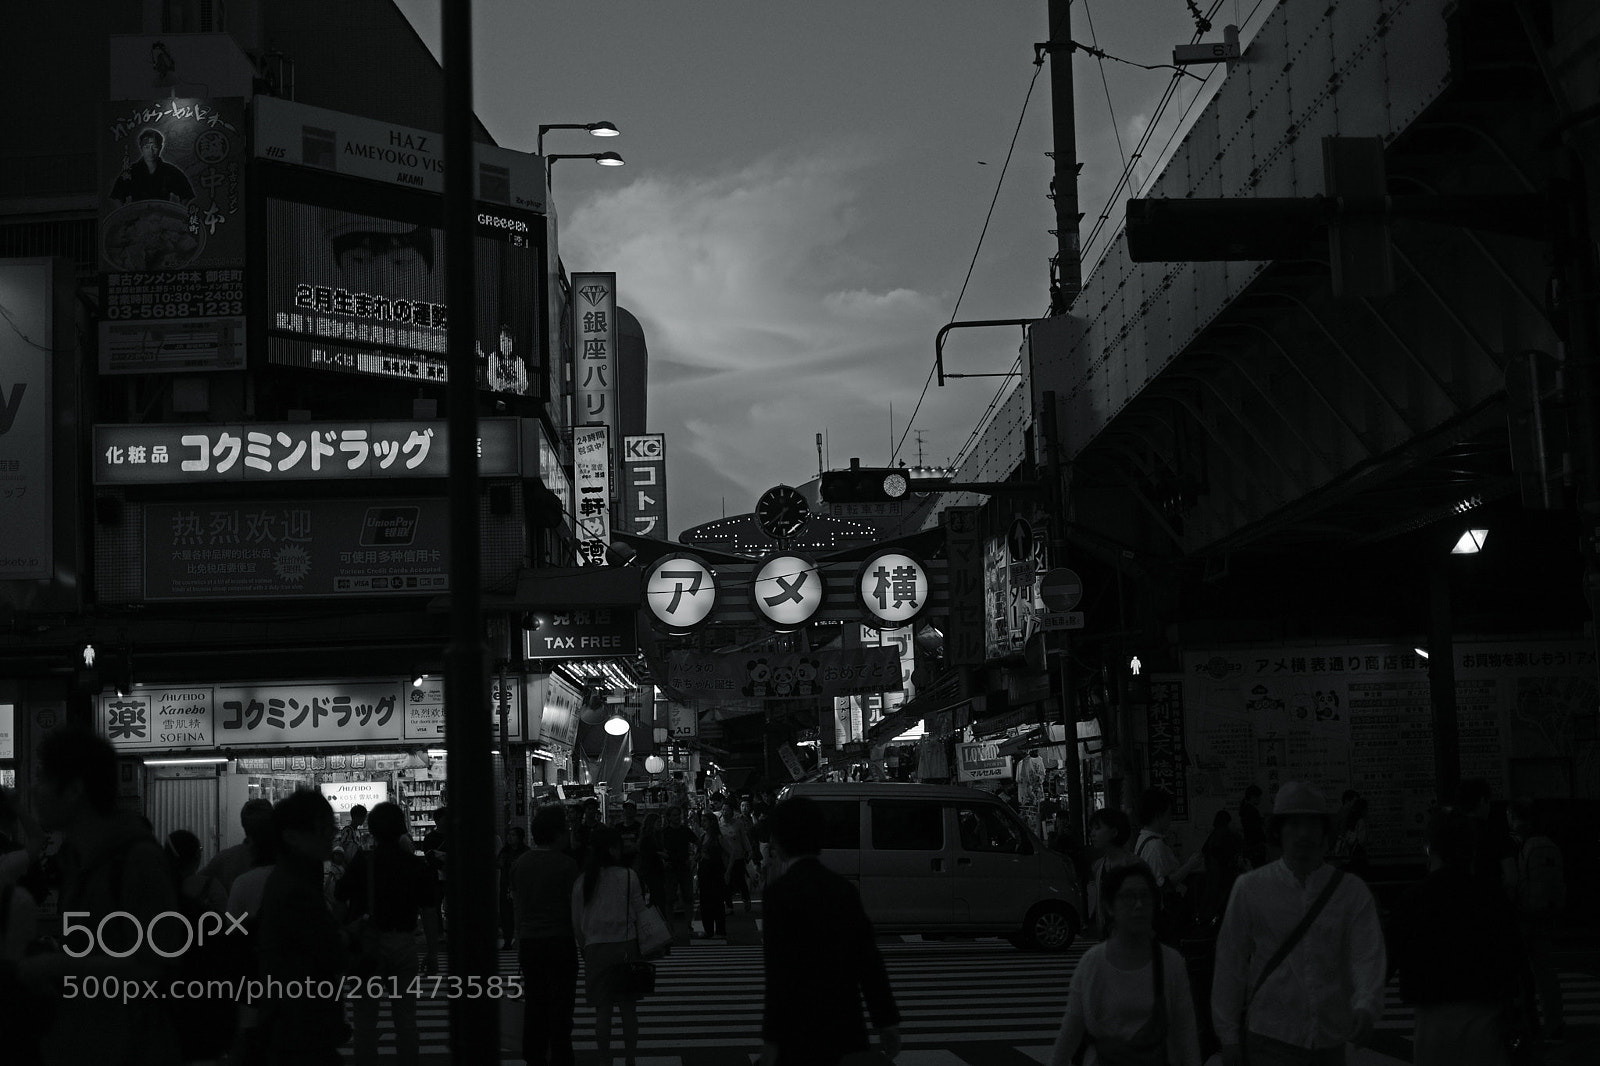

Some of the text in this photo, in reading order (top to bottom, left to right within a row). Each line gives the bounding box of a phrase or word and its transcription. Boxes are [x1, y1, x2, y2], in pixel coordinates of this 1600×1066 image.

[390, 129, 430, 154] HAZ
[344, 141, 419, 169] AMEYOKO
[396, 173, 425, 187] AKAMI
[201, 167, 227, 236] 中本
[107, 269, 244, 287] 蒙古タンメン中本 御徒町
[107, 301, 244, 319] 03-5688-1233
[583, 311, 608, 425] 銀座パリ
[576, 430, 605, 446] 24時間
[106, 428, 434, 473] 化粧品 コクミンドラッグ
[626, 440, 662, 458] KG
[834, 503, 900, 516] 自転車専用
[171, 508, 313, 546] 热烈欢迎
[366, 516, 415, 531] UnionPay
[339, 549, 442, 565] 可使用多种信用卡
[660, 565, 918, 614] アメ横
[544, 635, 622, 650] TAX FREE
[824, 661, 898, 681] おめでとう
[672, 678, 736, 690] 赤ちゃん誕生
[158, 693, 206, 702] SHISEIDO
[108, 694, 397, 739] 薬 コクミンドラッグ
[159, 705, 206, 716] Kanebo
[162, 718, 201, 732] 雪肌精
[676, 726, 691, 734] 入口
[159, 732, 206, 743] SOFINA
[963, 743, 1001, 763] LONDO
[970, 769, 1002, 777] マルセル店
